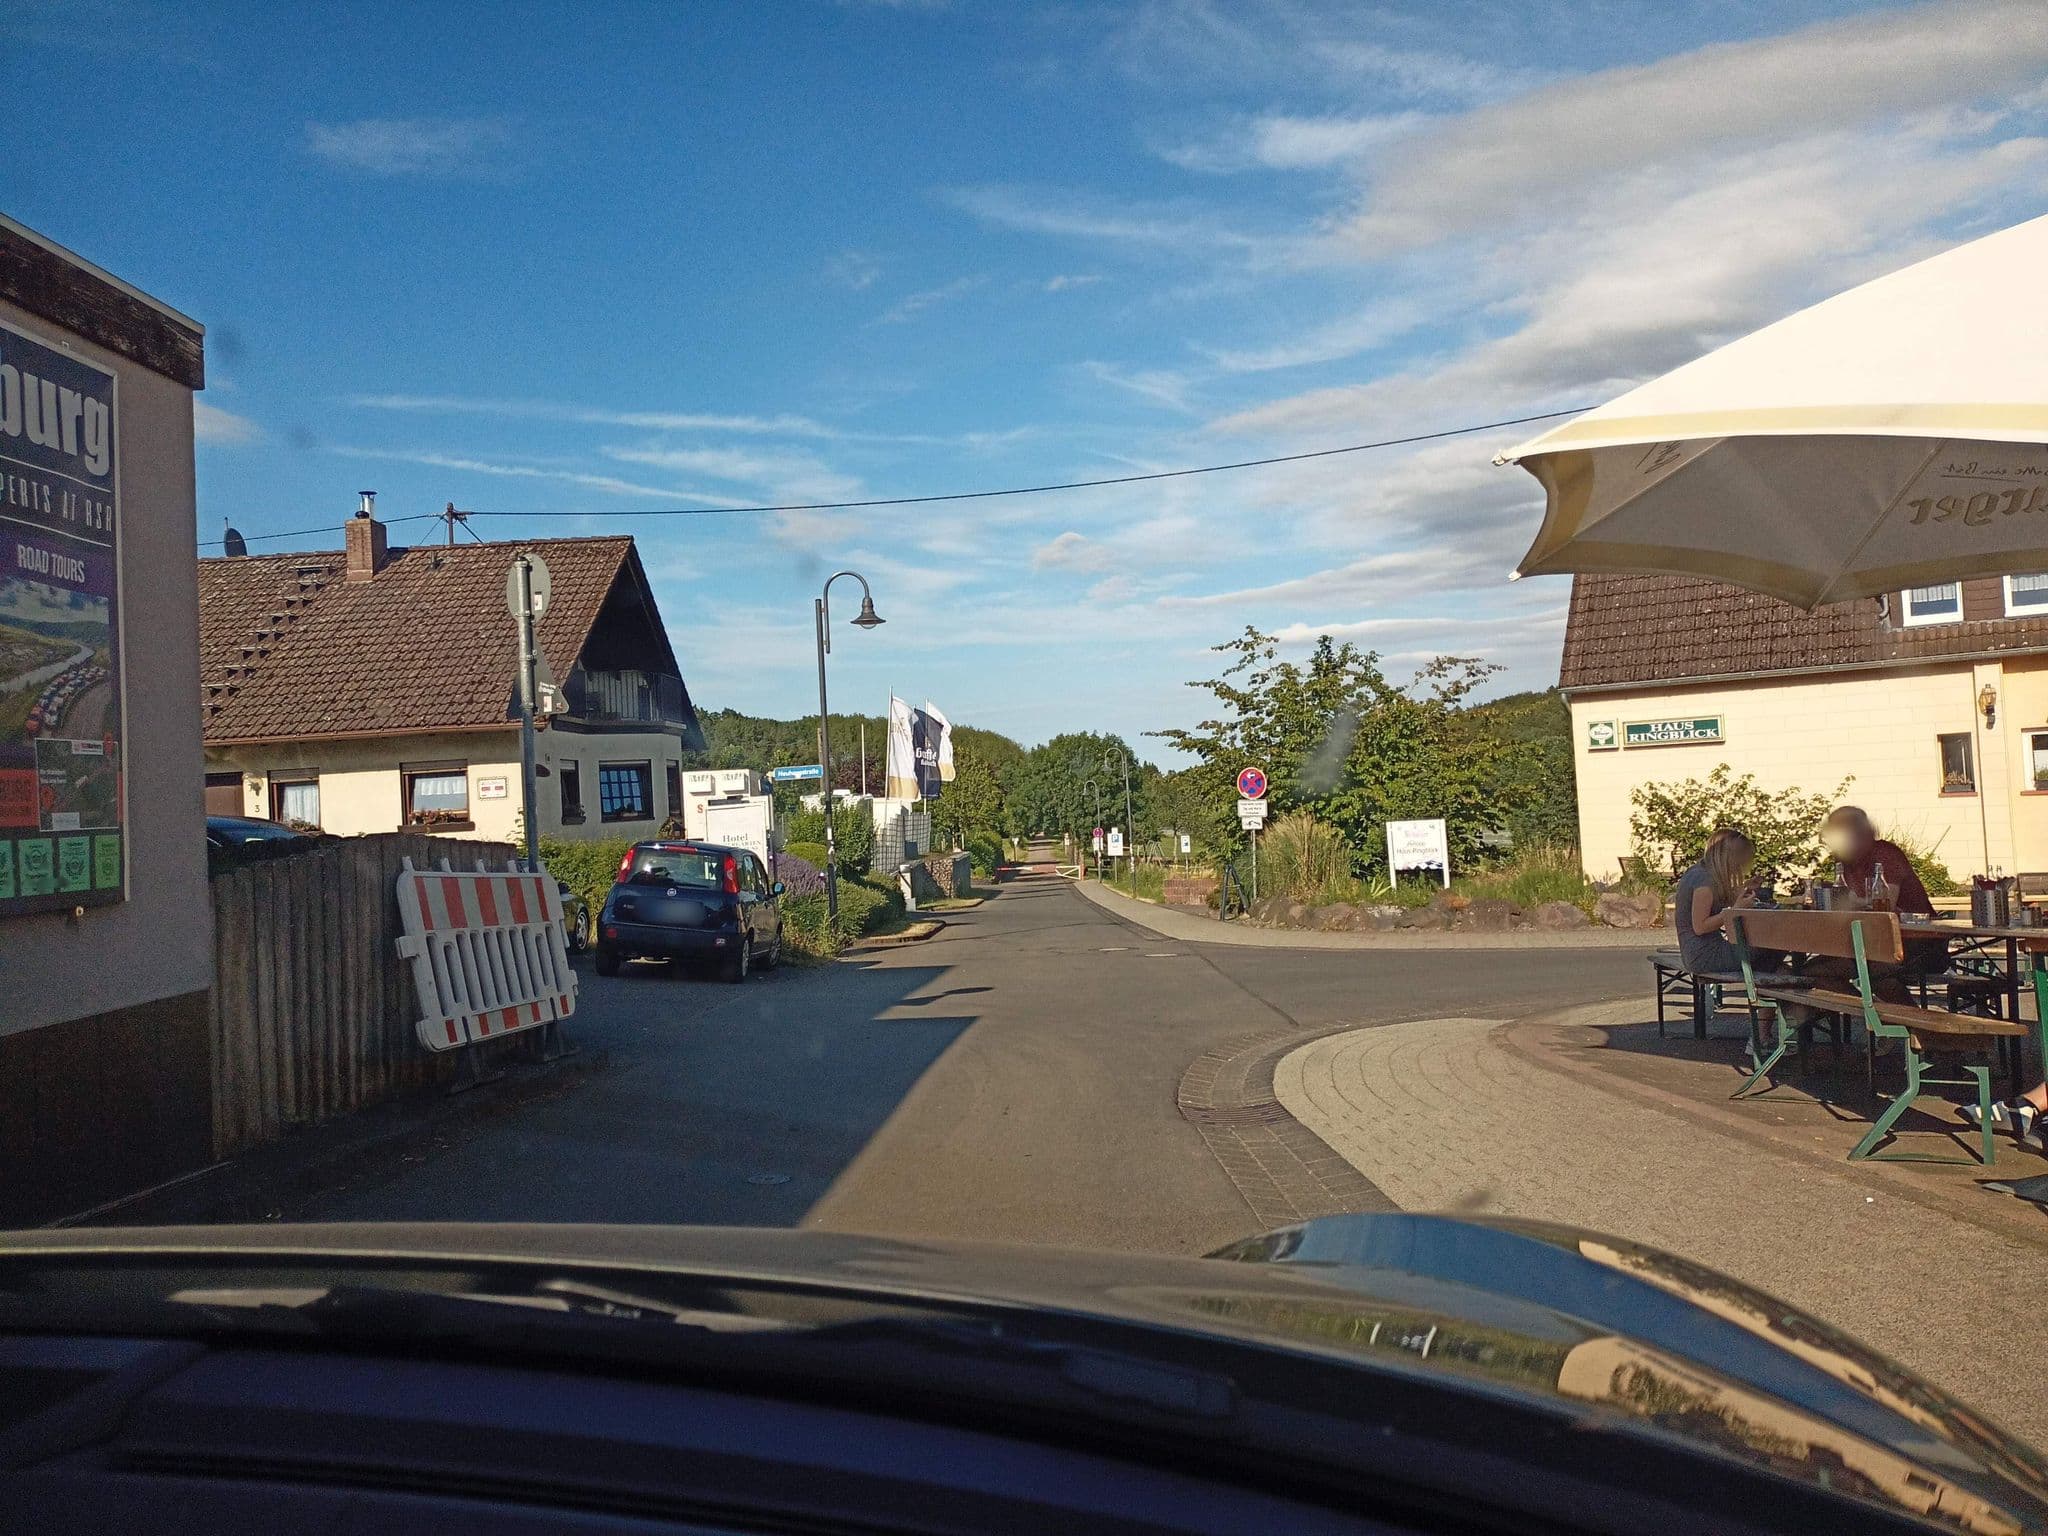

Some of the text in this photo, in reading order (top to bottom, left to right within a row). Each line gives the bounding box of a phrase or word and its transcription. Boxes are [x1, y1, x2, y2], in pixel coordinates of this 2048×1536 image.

[62, 490, 77, 521] AT
[85, 499, 113, 532] RSR
[17, 544, 86, 583] ROAD TOURS
[1650, 721, 1694, 732] HAUS
[1628, 728, 1717, 743] RINGBLICK
[722, 832, 749, 843] Hotel
